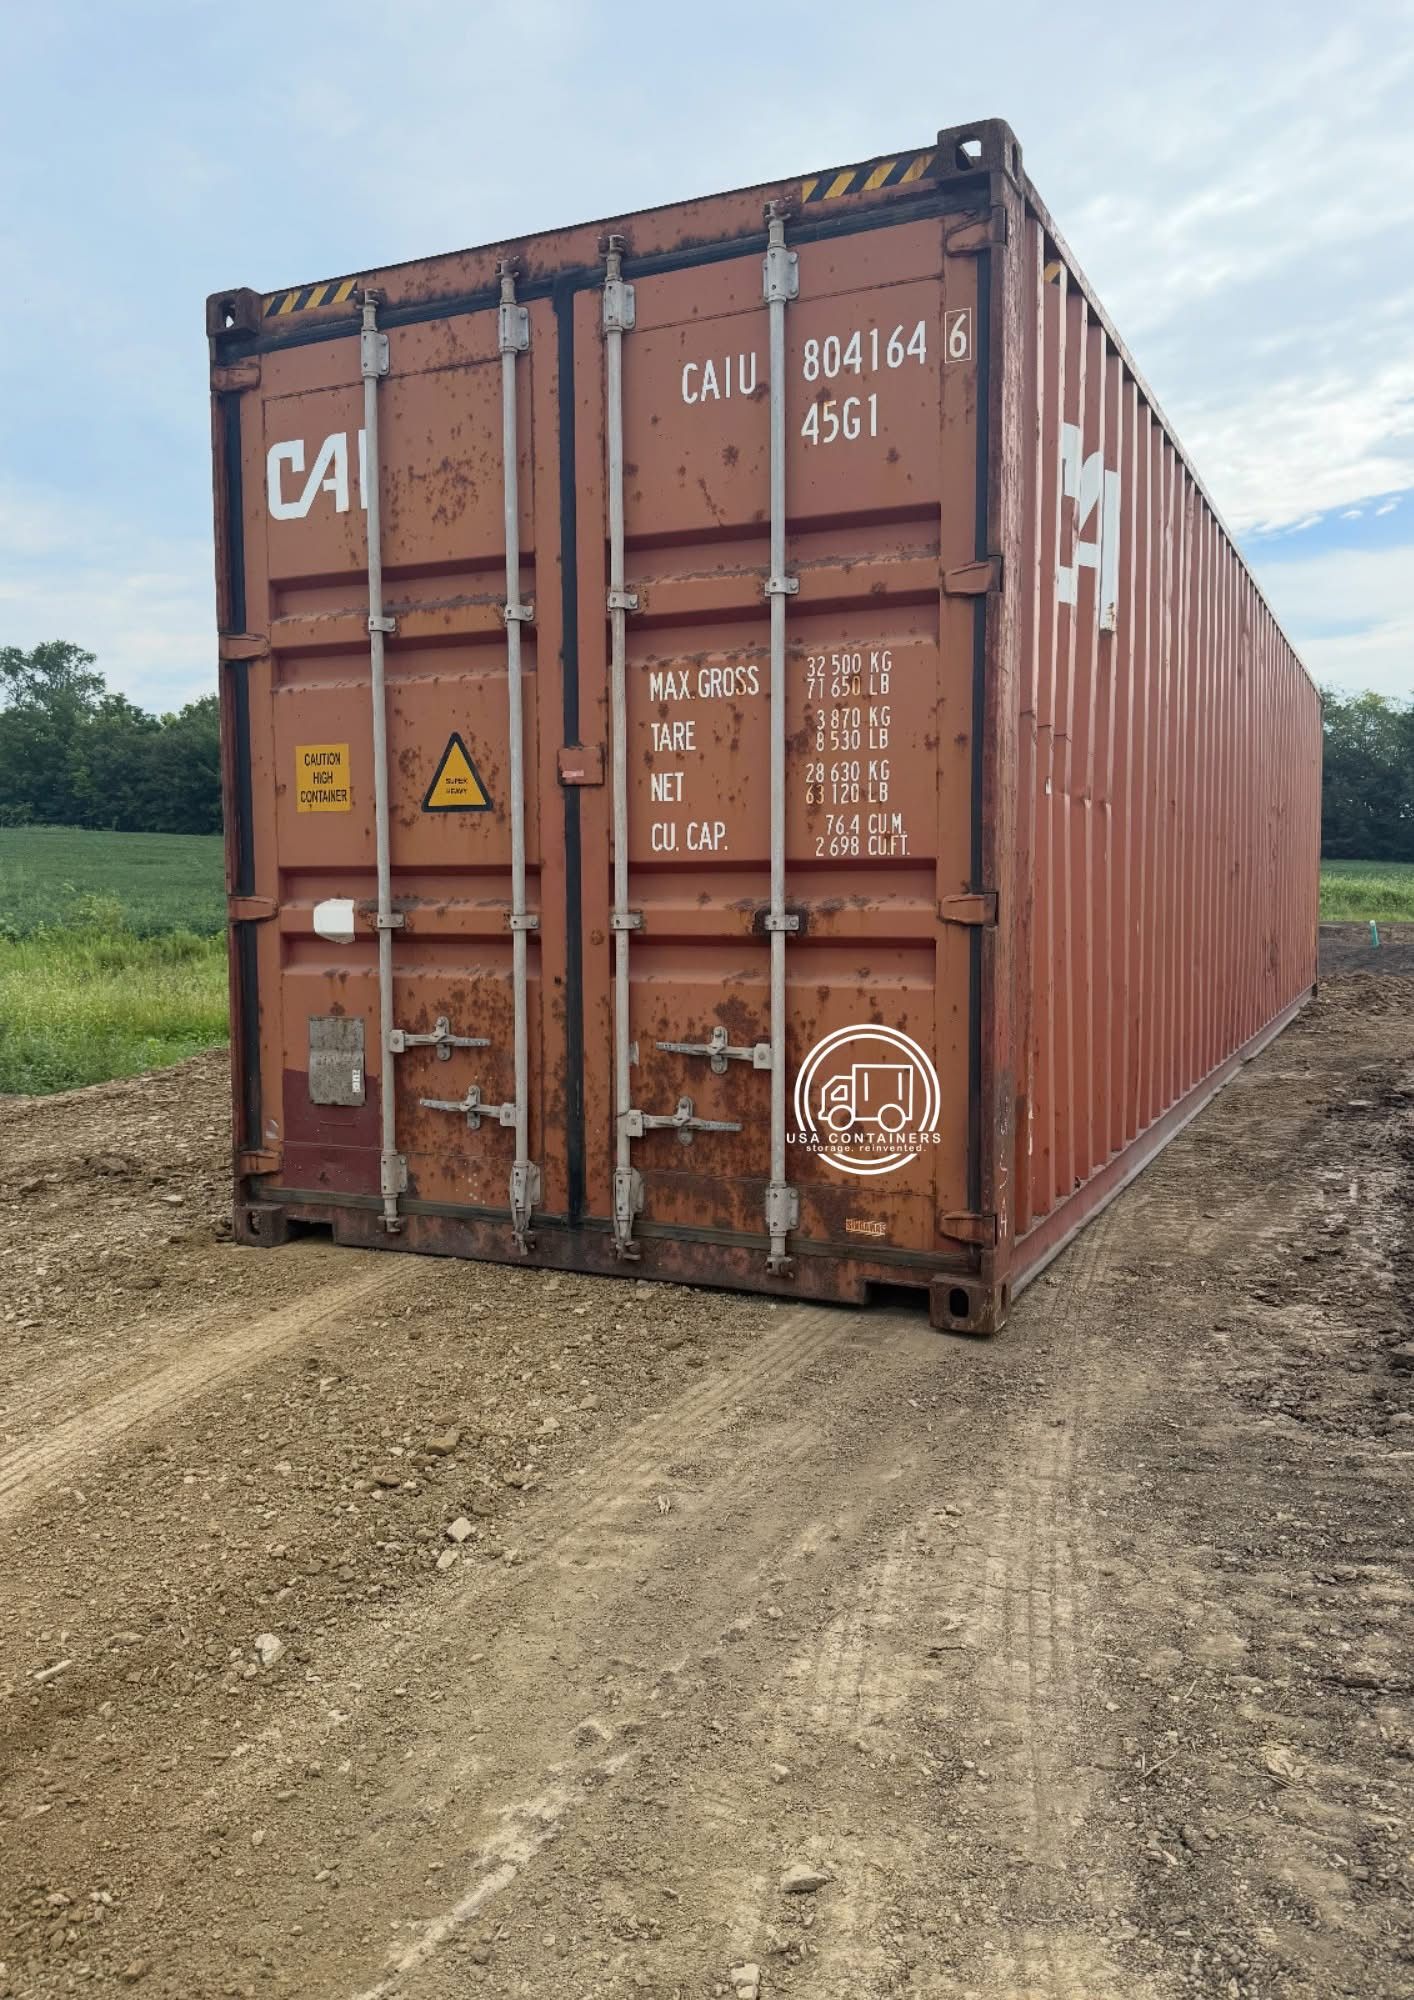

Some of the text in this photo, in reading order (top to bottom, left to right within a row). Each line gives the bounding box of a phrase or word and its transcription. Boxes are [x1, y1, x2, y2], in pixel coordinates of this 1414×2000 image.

[682, 313, 967, 404] CAIU 804164 6
[801, 393, 877, 446] 45G1
[807, 651, 892, 677] 32 500 KG
[699, 666, 760, 699] GROSS
[807, 673, 890, 699] 71 650 LB
[816, 706, 891, 730] 3 870 KG
[651, 721, 696, 751] TARE
[816, 728, 889, 751] 8 530 LB
[304, 752, 341, 767] CAUTION
[806, 760, 891, 783] 28 630 KG
[313, 771, 333, 785] HIGH
[650, 772, 685, 802] NET
[300, 789, 347, 804] CONTAINER
[806, 782, 889, 805] 63 120 LB
[826, 814, 860, 834] 76.4
[651, 822, 728, 851] CU. CAP.
[815, 837, 825, 857] 2
[830, 836, 860, 856] 698
